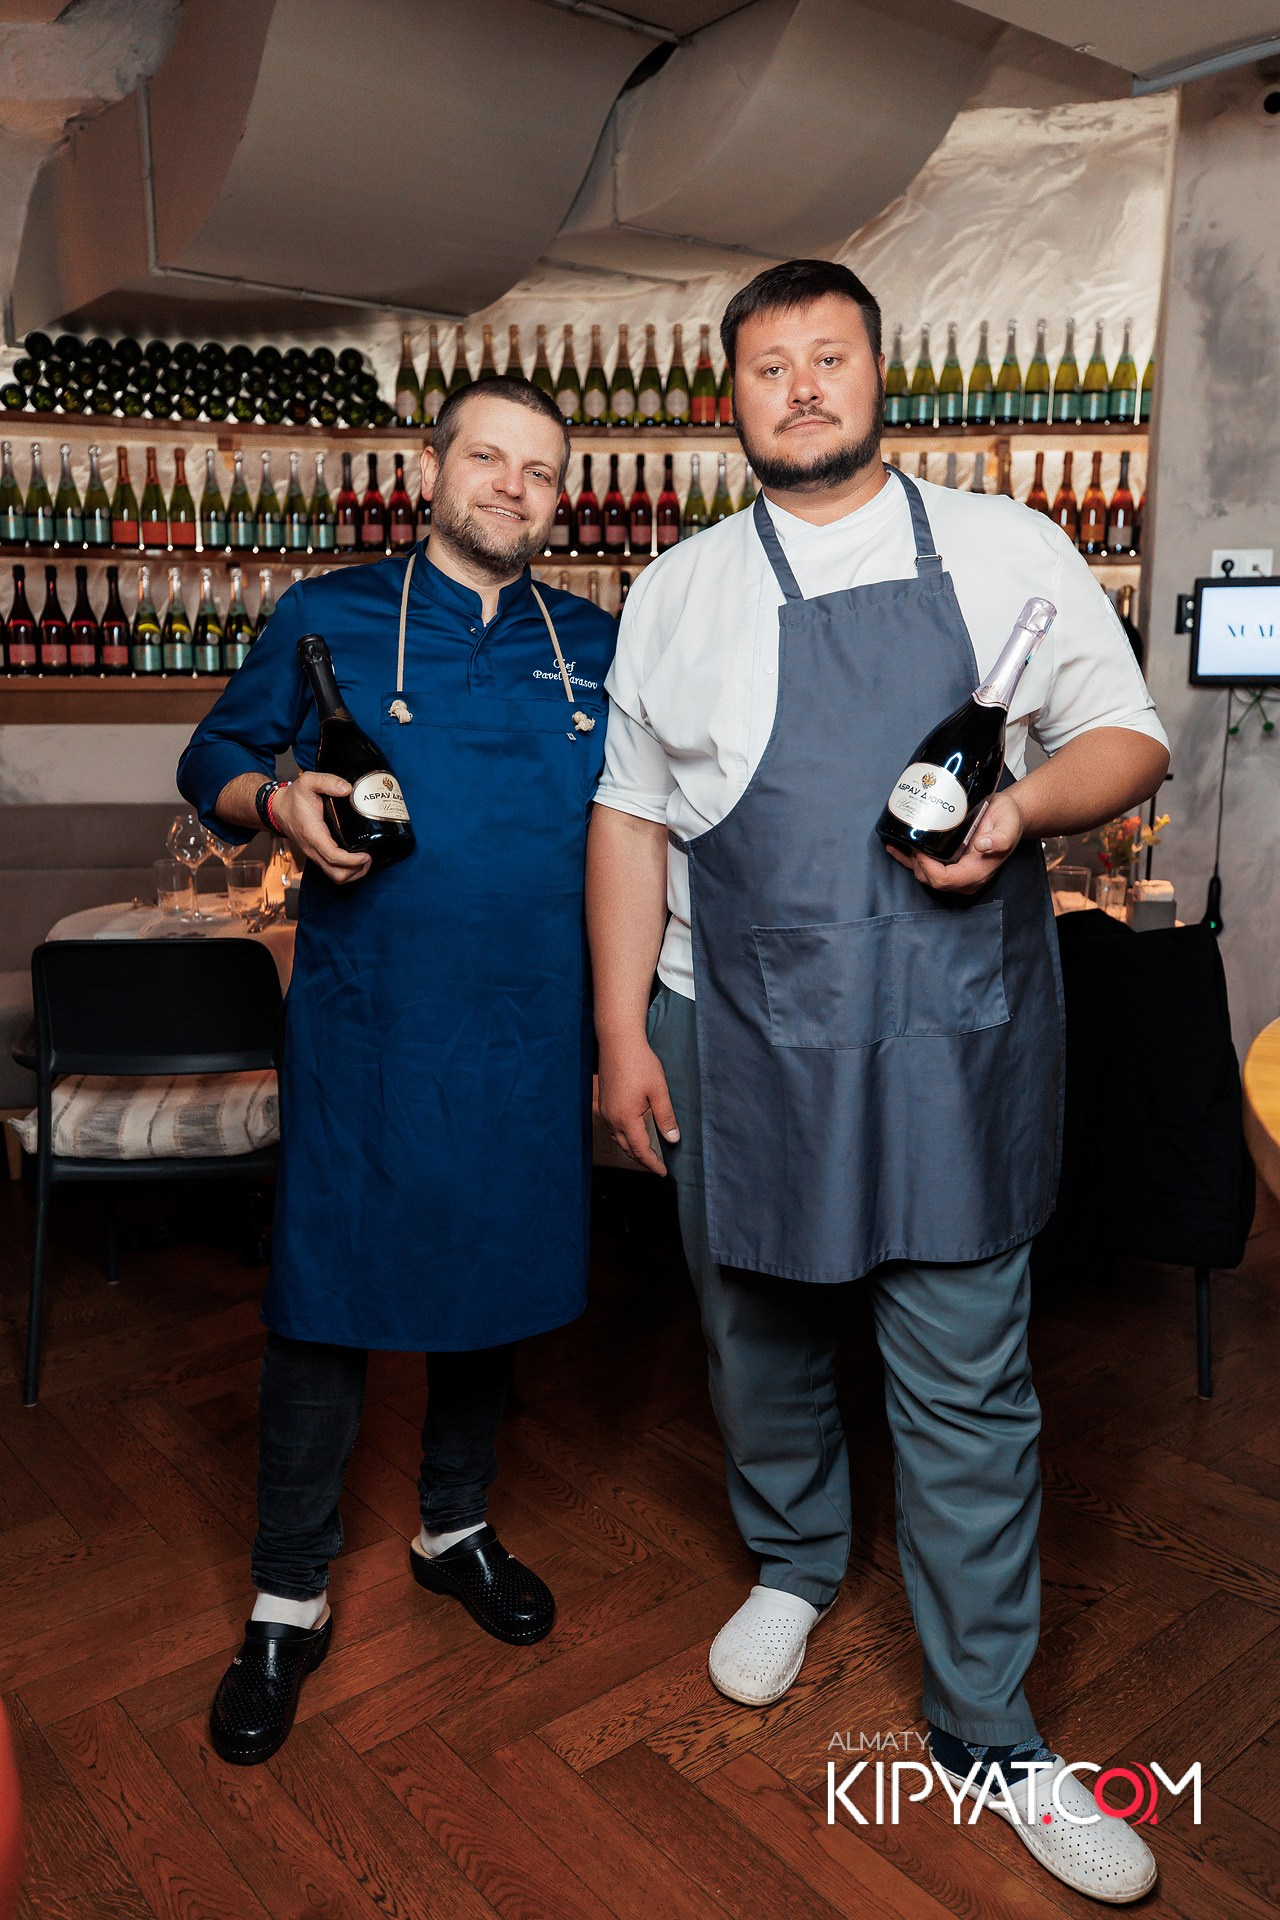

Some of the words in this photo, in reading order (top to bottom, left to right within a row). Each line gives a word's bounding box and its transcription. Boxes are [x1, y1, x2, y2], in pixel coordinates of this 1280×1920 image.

[553, 658, 576, 673] Cef
[533, 669, 563, 681] Pavel
[363, 792, 391, 801] АБРАУ
[897, 782, 921, 796] АБРАУ
[920, 792, 956, 813] ДЮРСО
